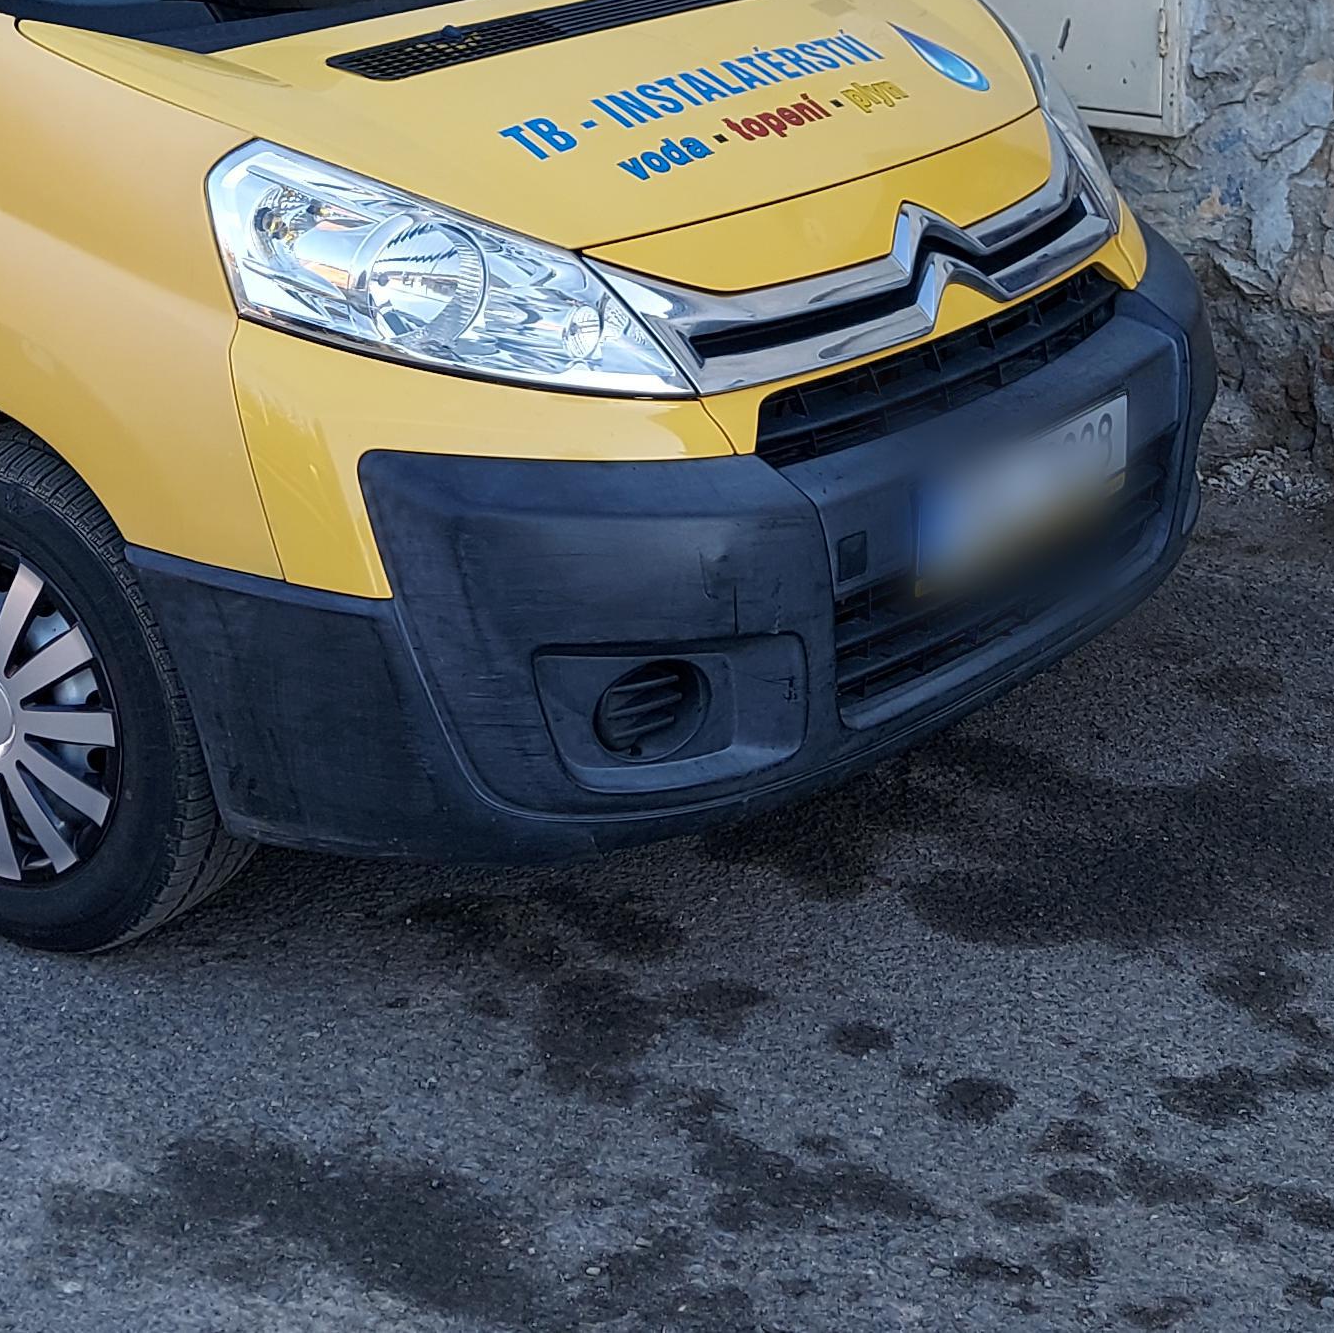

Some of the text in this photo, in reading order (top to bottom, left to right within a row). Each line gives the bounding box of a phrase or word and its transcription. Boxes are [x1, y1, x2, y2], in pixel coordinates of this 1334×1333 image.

[498, 117, 578, 160] TB
[590, 29, 886, 129] INSTALATÉRSTVÍ
[616, 80, 910, 181] voda topení plyn
